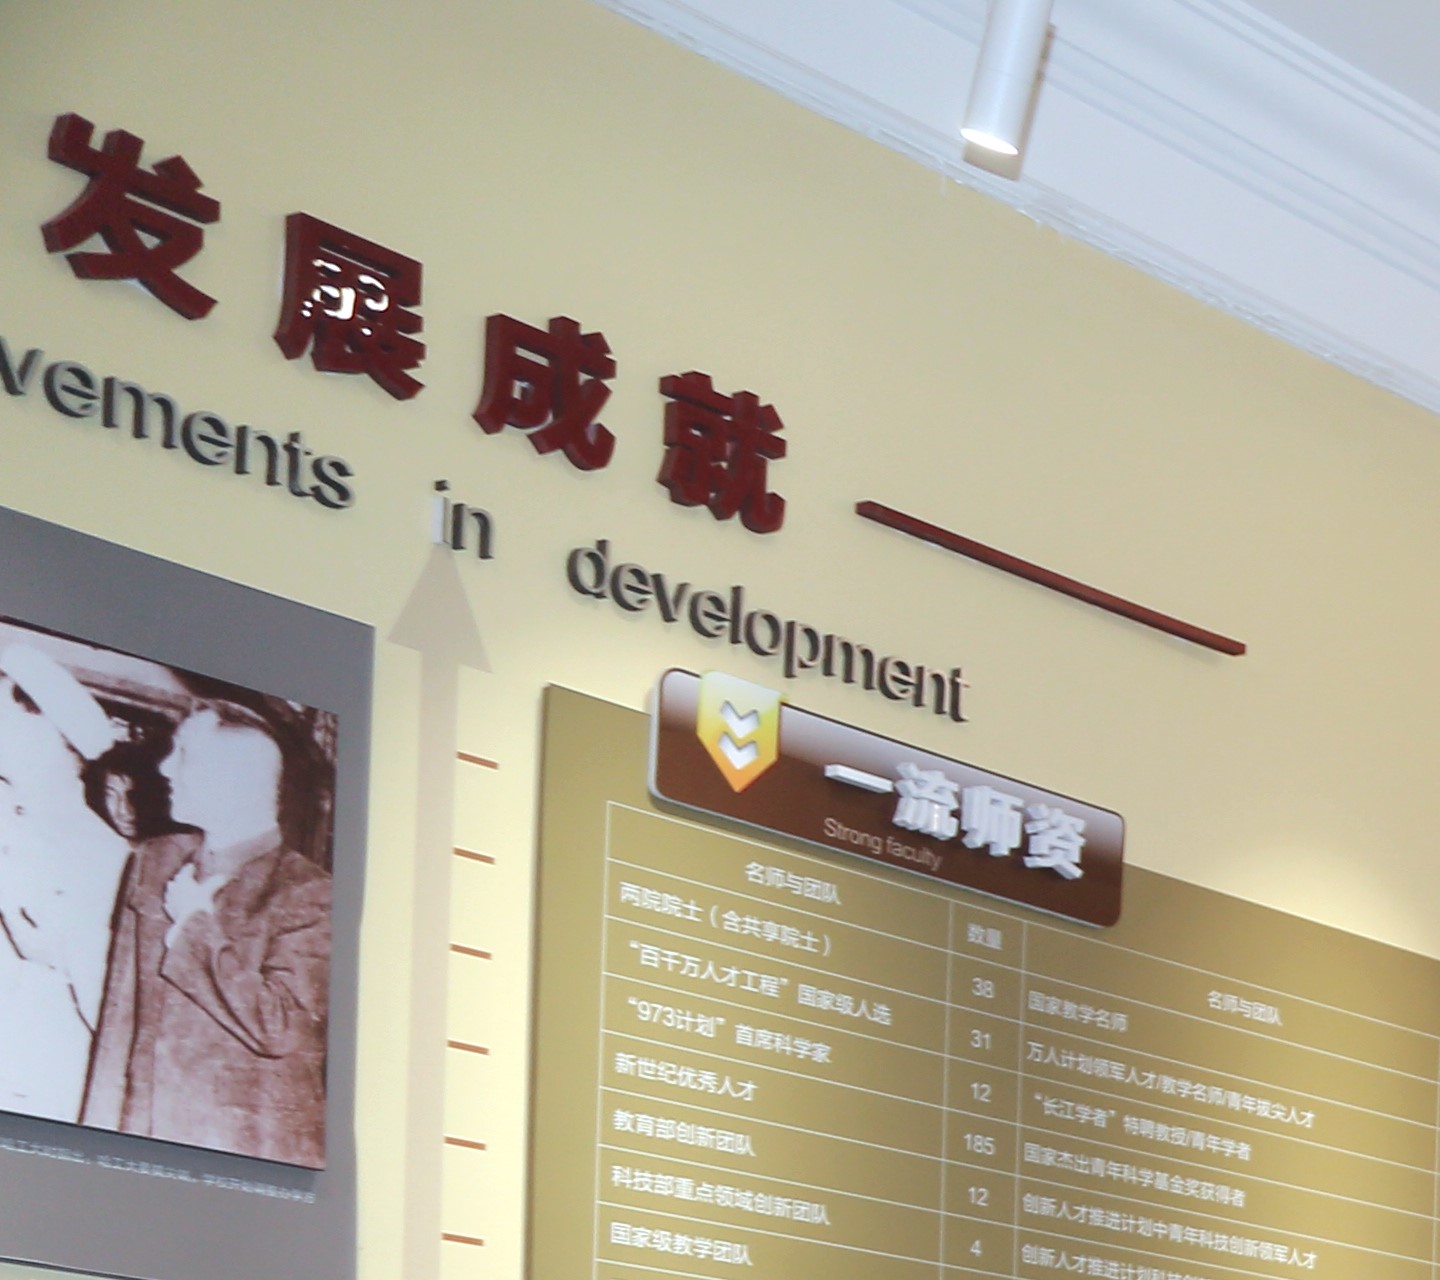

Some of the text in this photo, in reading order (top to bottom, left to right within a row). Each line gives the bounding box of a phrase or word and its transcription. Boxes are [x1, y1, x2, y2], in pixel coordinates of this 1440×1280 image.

[40, 112, 787, 535] 发展成就
[432, 478, 495, 559] in
[567, 540, 969, 723] development
[823, 817, 944, 872] Strong faculty
[824, 762, 1086, 880] 一流师资
[745, 861, 842, 905] 名师与团队
[967, 922, 1002, 951] 数量
[1207, 989, 1284, 1028] 名师与团队
[970, 1030, 992, 1050] 31
[972, 976, 995, 999] 38
[1028, 990, 1129, 1034] 国家教学名师
[614, 1052, 759, 1102] 新世纪优秀人才
[963, 1133, 996, 1156] 185
[1024, 1142, 1246, 1208] 国家杰出青年科学基金奖获得者
[970, 1082, 992, 1103] 12
[611, 1165, 831, 1226] 科技部重点领域创新团队
[970, 1239, 983, 1257] 4
[613, 1108, 757, 1158] 教育部创新团队
[967, 1186, 989, 1207] 12
[1022, 1193, 1318, 1271] 创新人才推进计划中青年科技创新领军人才
[610, 1221, 753, 1266] 国家级教学团队
